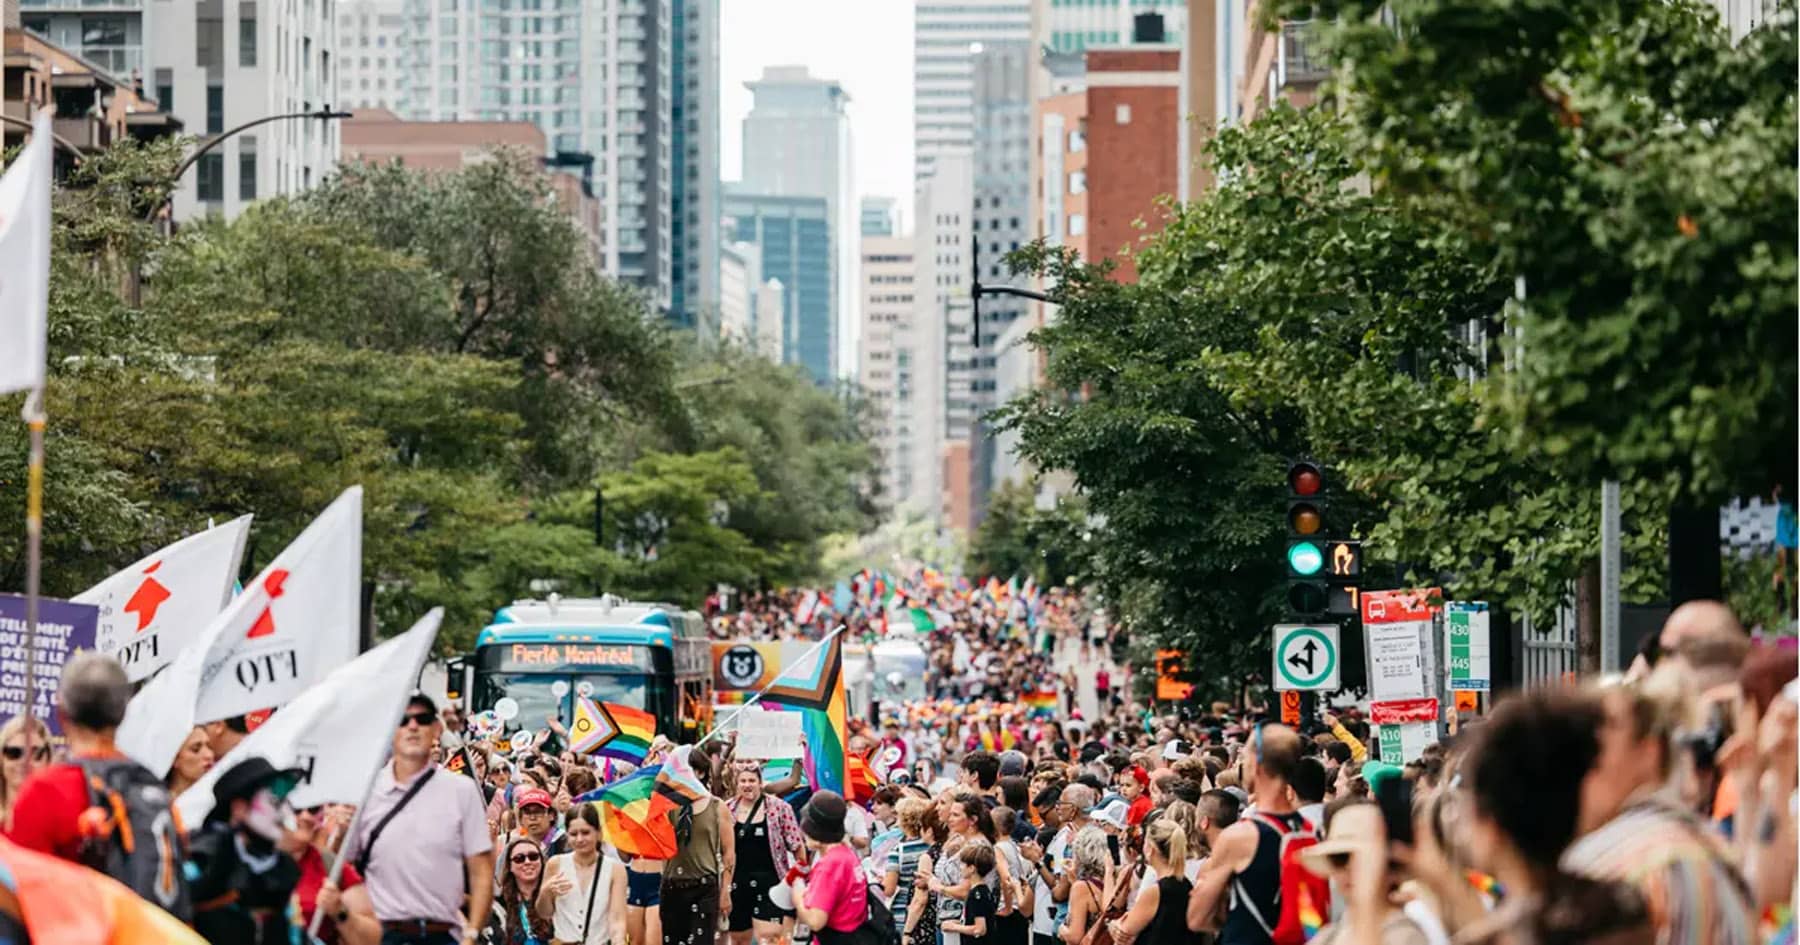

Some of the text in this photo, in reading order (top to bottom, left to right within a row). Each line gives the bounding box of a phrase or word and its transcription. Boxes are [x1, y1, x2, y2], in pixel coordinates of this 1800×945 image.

[1343, 586, 1357, 610] 7
[0, 618, 74, 637] TELLMENT
[1451, 624, 1469, 635] 430
[0, 632, 70, 652] DE FERTÉ,
[49, 651, 64, 664] LE
[512, 644, 633, 664] Fierté Montréal
[2, 660, 61, 678] PREIER
[1452, 658, 1470, 669] 445
[1381, 729, 1400, 741] 410
